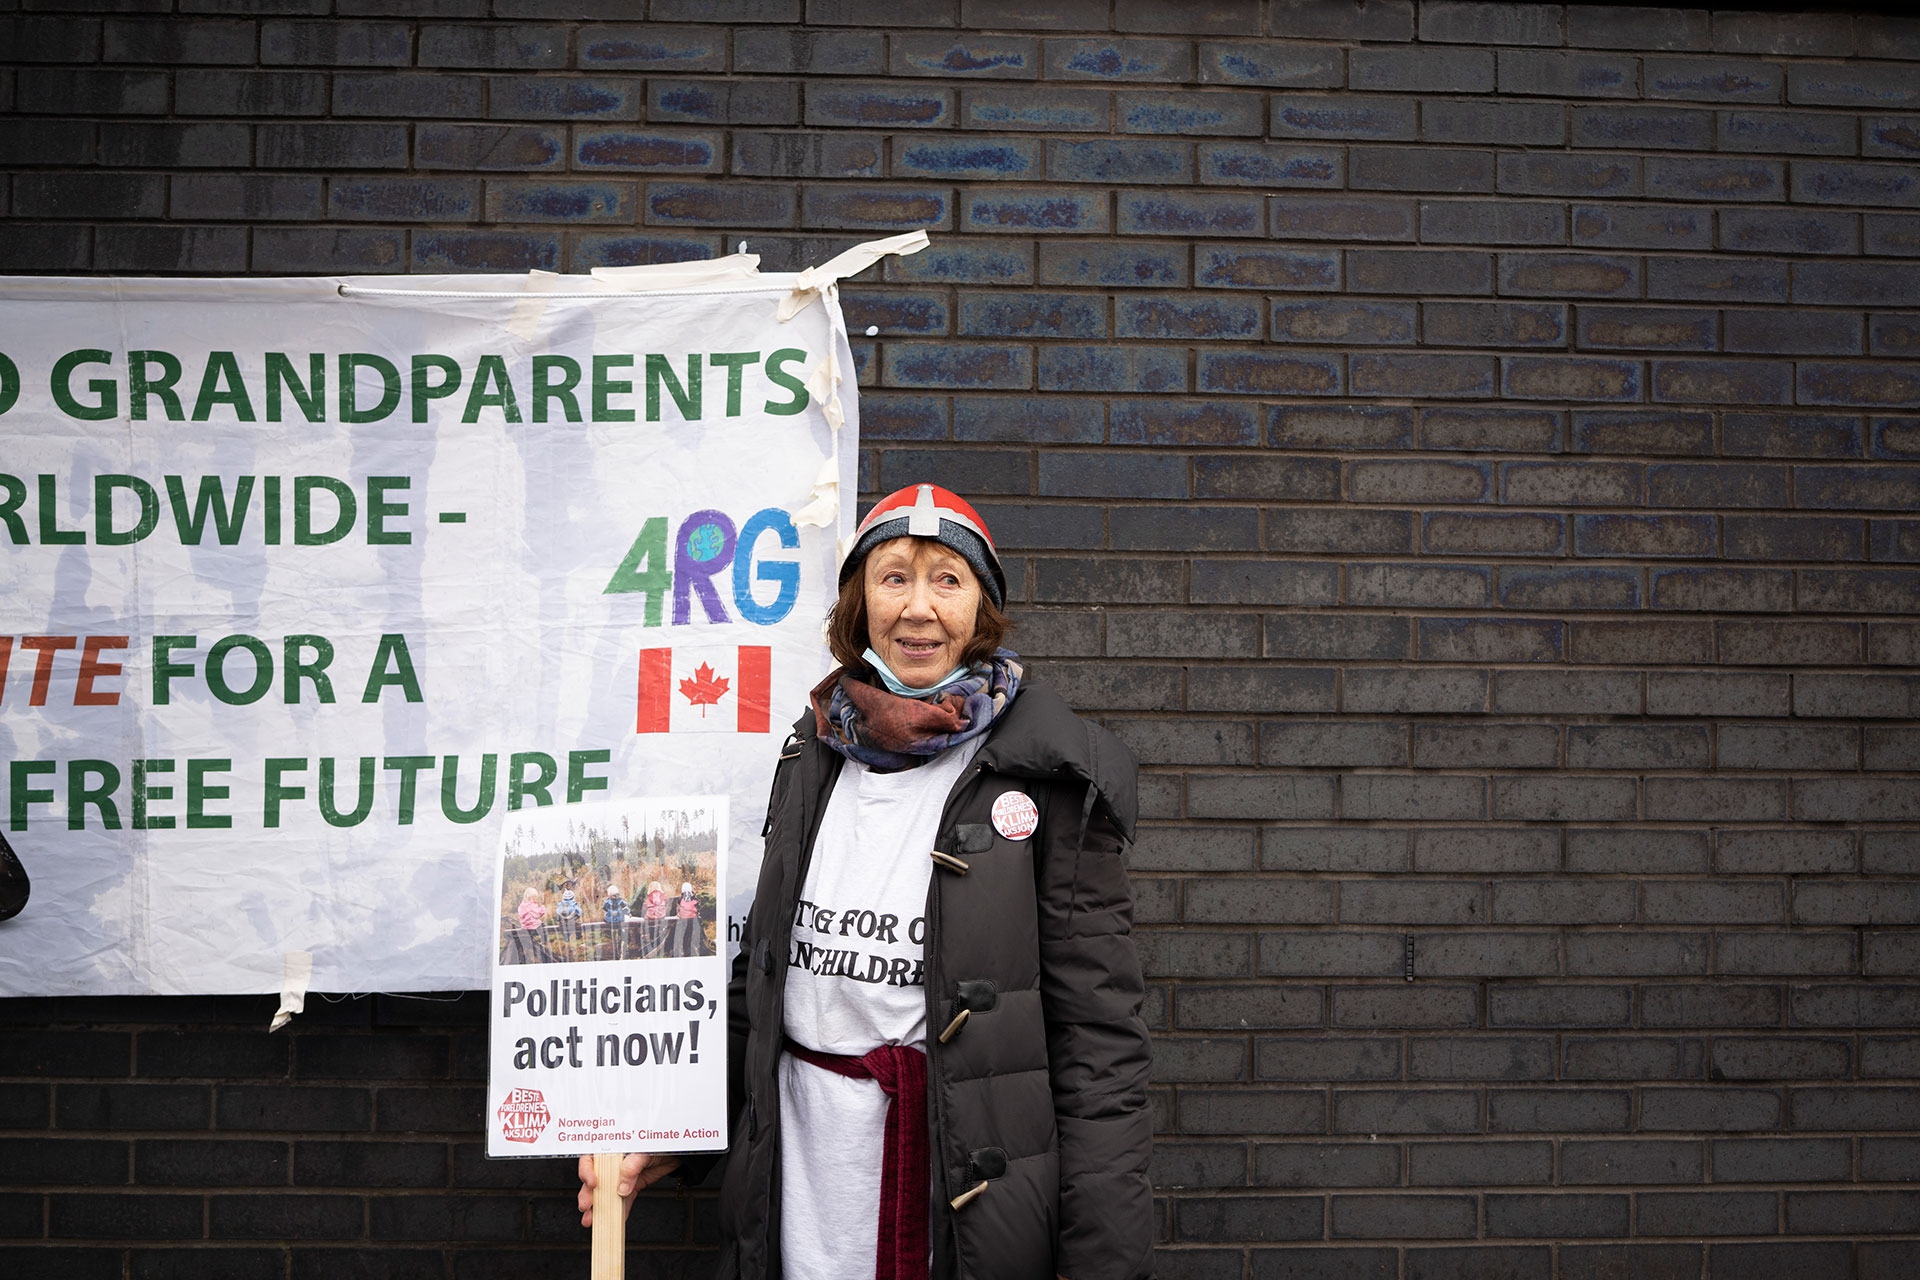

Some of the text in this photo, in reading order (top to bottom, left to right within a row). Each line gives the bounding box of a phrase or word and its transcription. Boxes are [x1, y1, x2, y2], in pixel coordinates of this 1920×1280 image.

[51, 348, 810, 424] GRANDPARENTS
[602, 507, 800, 627] 4RG
[152, 634, 337, 706] FOR
[361, 633, 424, 703] A
[10, 758, 232, 832] FREE
[996, 811, 1036, 829] KLIMA
[838, 909, 899, 945] FOR
[503, 976, 717, 1019] Politicians,
[513, 1020, 700, 1070] act now!
[512, 1089, 540, 1104] BESTE
[500, 1111, 548, 1129] KLIMA
[503, 1127, 541, 1139] AKSJON
[558, 1117, 616, 1129] Norwegian
[638, 1129, 680, 1140] Climate
[683, 1128, 719, 1139] Action
